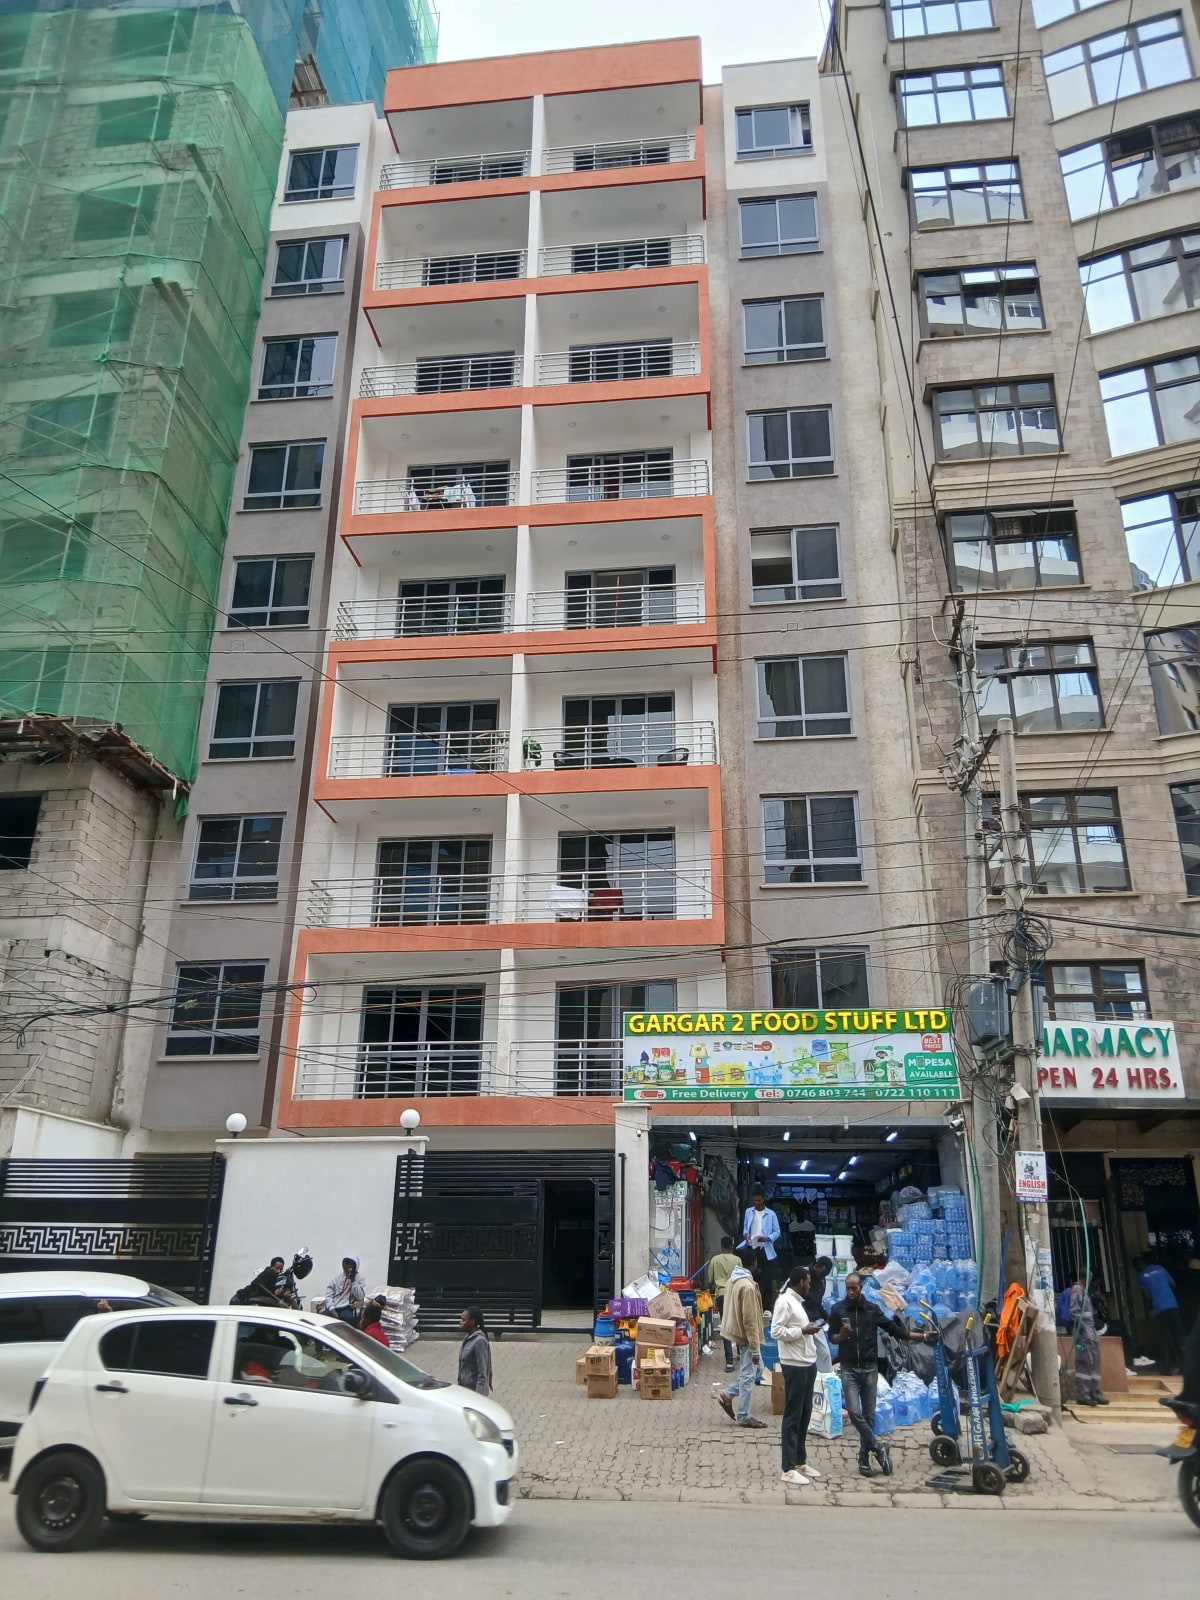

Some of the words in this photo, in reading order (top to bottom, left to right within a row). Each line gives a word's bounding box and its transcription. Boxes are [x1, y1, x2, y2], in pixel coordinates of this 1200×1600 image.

[629, 1014, 726, 1033] GARGAR
[731, 1013, 745, 1032] 2
[751, 1012, 819, 1032] FOOD
[824, 1011, 897, 1031] STUFF
[904, 1010, 948, 1030] LTD
[909, 1070, 954, 1078] AVAILABLE
[1037, 1067, 1077, 1089] PEN
[1091, 1067, 1119, 1089] 24
[1126, 1067, 1178, 1089] HRS.
[672, 1089, 697, 1098] Free
[700, 1089, 749, 1099] Delivery
[760, 1089, 780, 1098] Tel:
[786, 1089, 816, 1098] 0746
[819, 1088, 840, 1098] 803
[875, 1088, 906, 1097] 0722
[909, 1088, 931, 1097] 110
[934, 1088, 956, 1097] 111
[1018, 1179, 1046, 1190] ENGLISH
